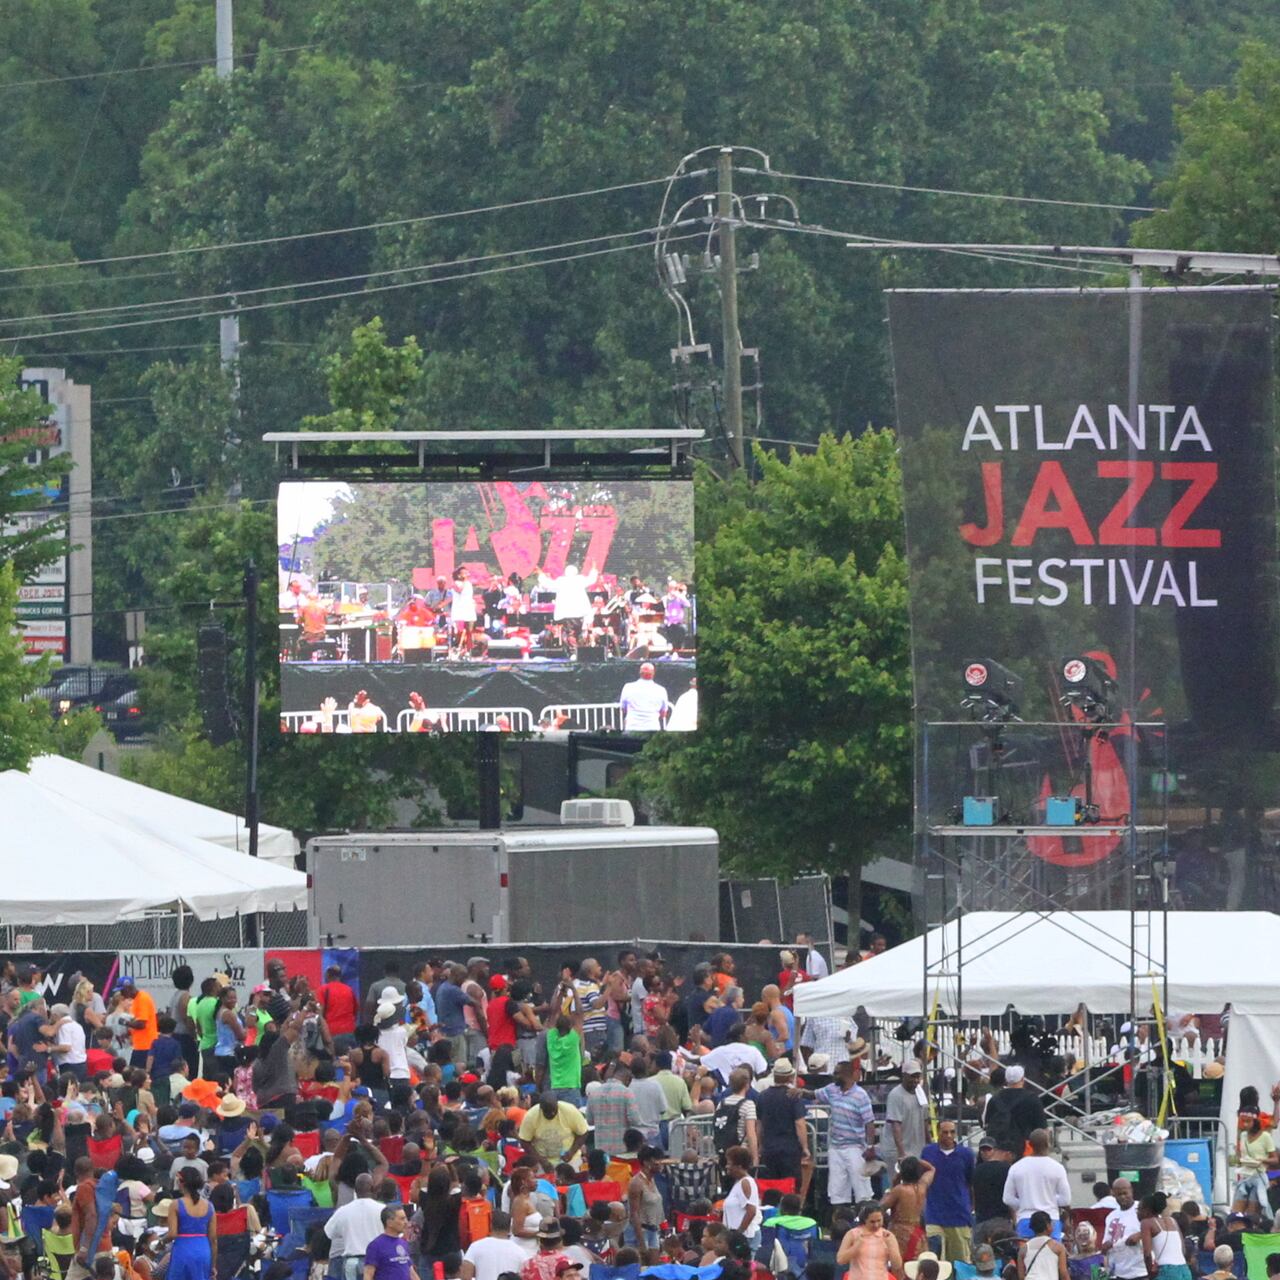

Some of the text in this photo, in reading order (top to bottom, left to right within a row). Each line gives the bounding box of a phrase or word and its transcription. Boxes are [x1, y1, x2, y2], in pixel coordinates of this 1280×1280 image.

[962, 404, 1213, 452] ATLANTA
[959, 461, 1222, 549] JAZZ
[976, 557, 1219, 608] FESTIVAL
